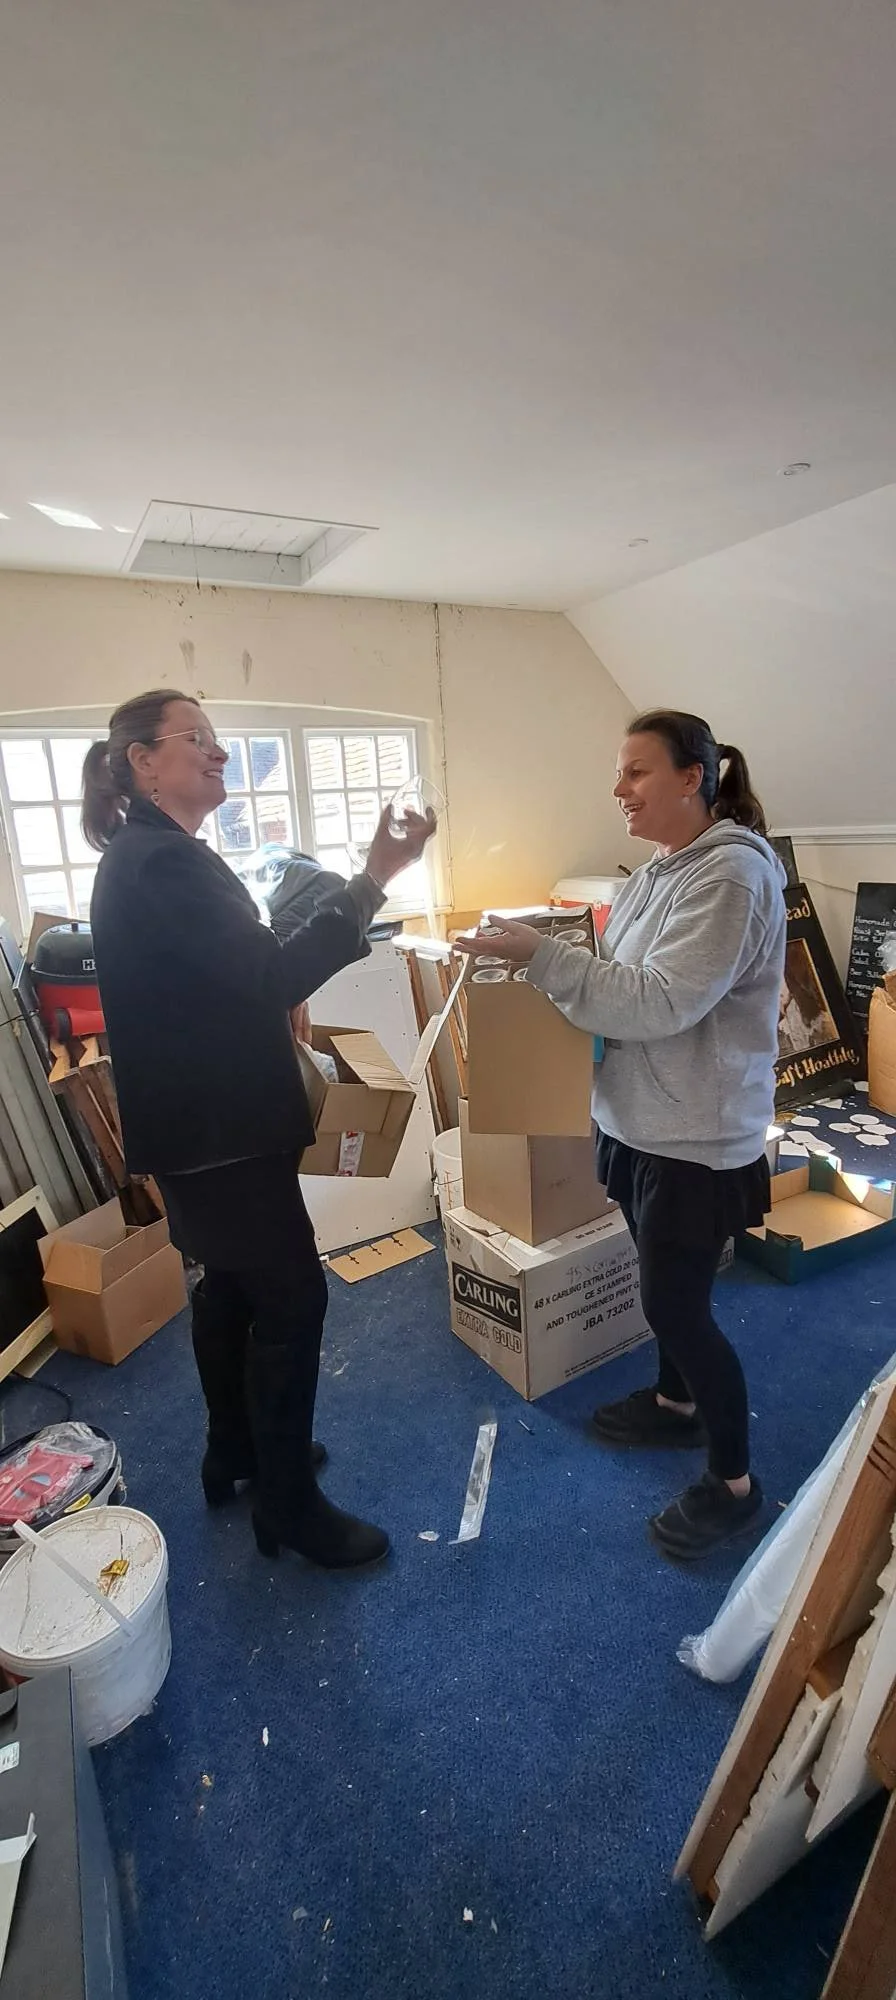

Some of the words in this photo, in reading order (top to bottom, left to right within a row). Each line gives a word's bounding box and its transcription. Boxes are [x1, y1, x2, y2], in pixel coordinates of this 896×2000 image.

[455, 1272, 519, 1318] CARLING
[551, 1283, 582, 1302] CARLING
[583, 1273, 605, 1290] EXTRA
[605, 1264, 623, 1279] COLD
[584, 1289, 595, 1301] CE
[596, 1272, 632, 1293] STAMPED
[546, 1316, 564, 1331] AND
[566, 1293, 615, 1321] TOUGHENED
[615, 1284, 633, 1299] PINT
[582, 1313, 604, 1331] JBA
[606, 1297, 635, 1320] 73202
[456, 1306, 490, 1340] EXTRA
[492, 1325, 522, 1354] COLD
